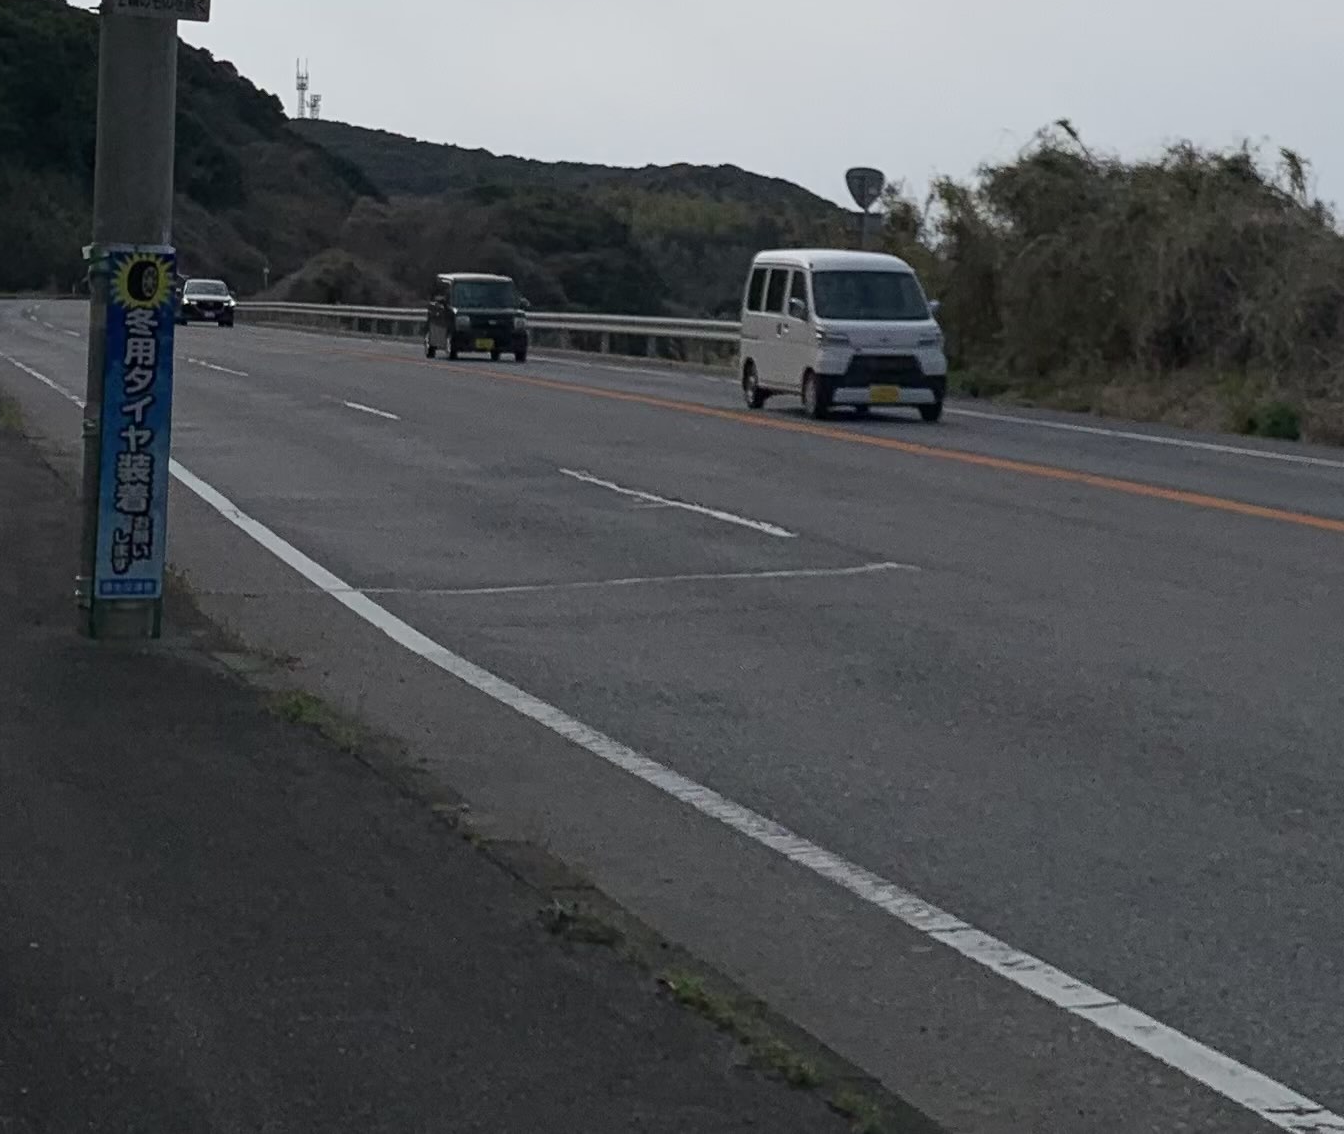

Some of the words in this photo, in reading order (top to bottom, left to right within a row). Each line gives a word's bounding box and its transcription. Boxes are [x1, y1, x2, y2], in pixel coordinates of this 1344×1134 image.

[115, 307, 159, 514] 冬用タイヤ装着
